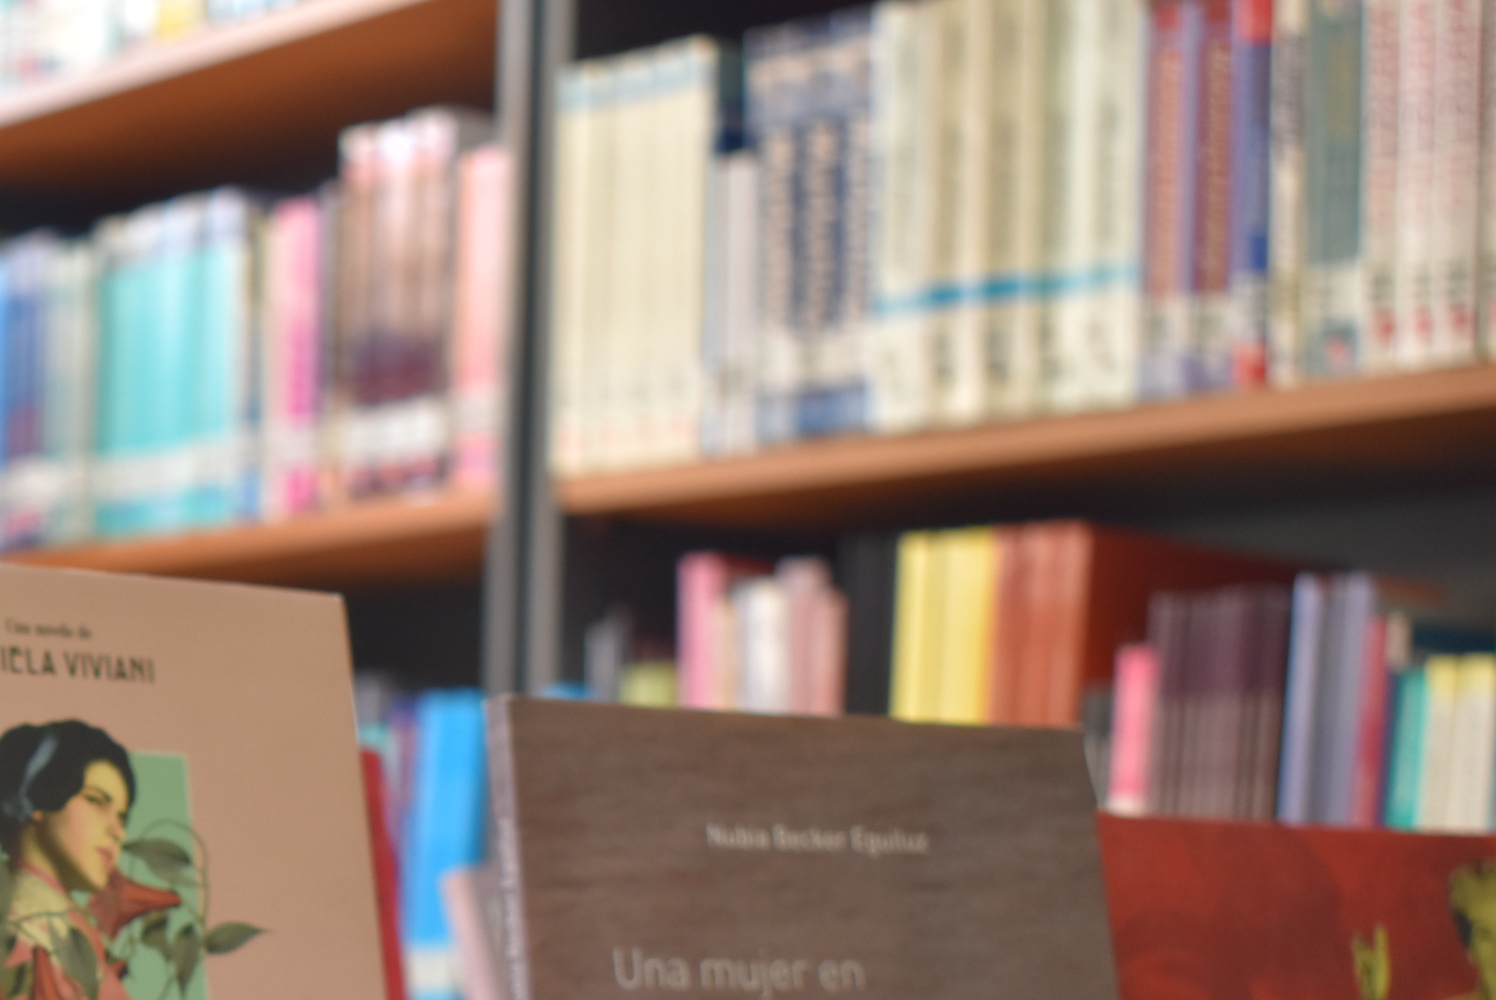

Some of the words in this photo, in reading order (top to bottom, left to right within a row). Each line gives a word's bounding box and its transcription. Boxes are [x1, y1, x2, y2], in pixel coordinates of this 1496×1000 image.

[62, 651, 157, 684] VIVIANI
[612, 947, 691, 991] Una
[817, 960, 866, 991] en
